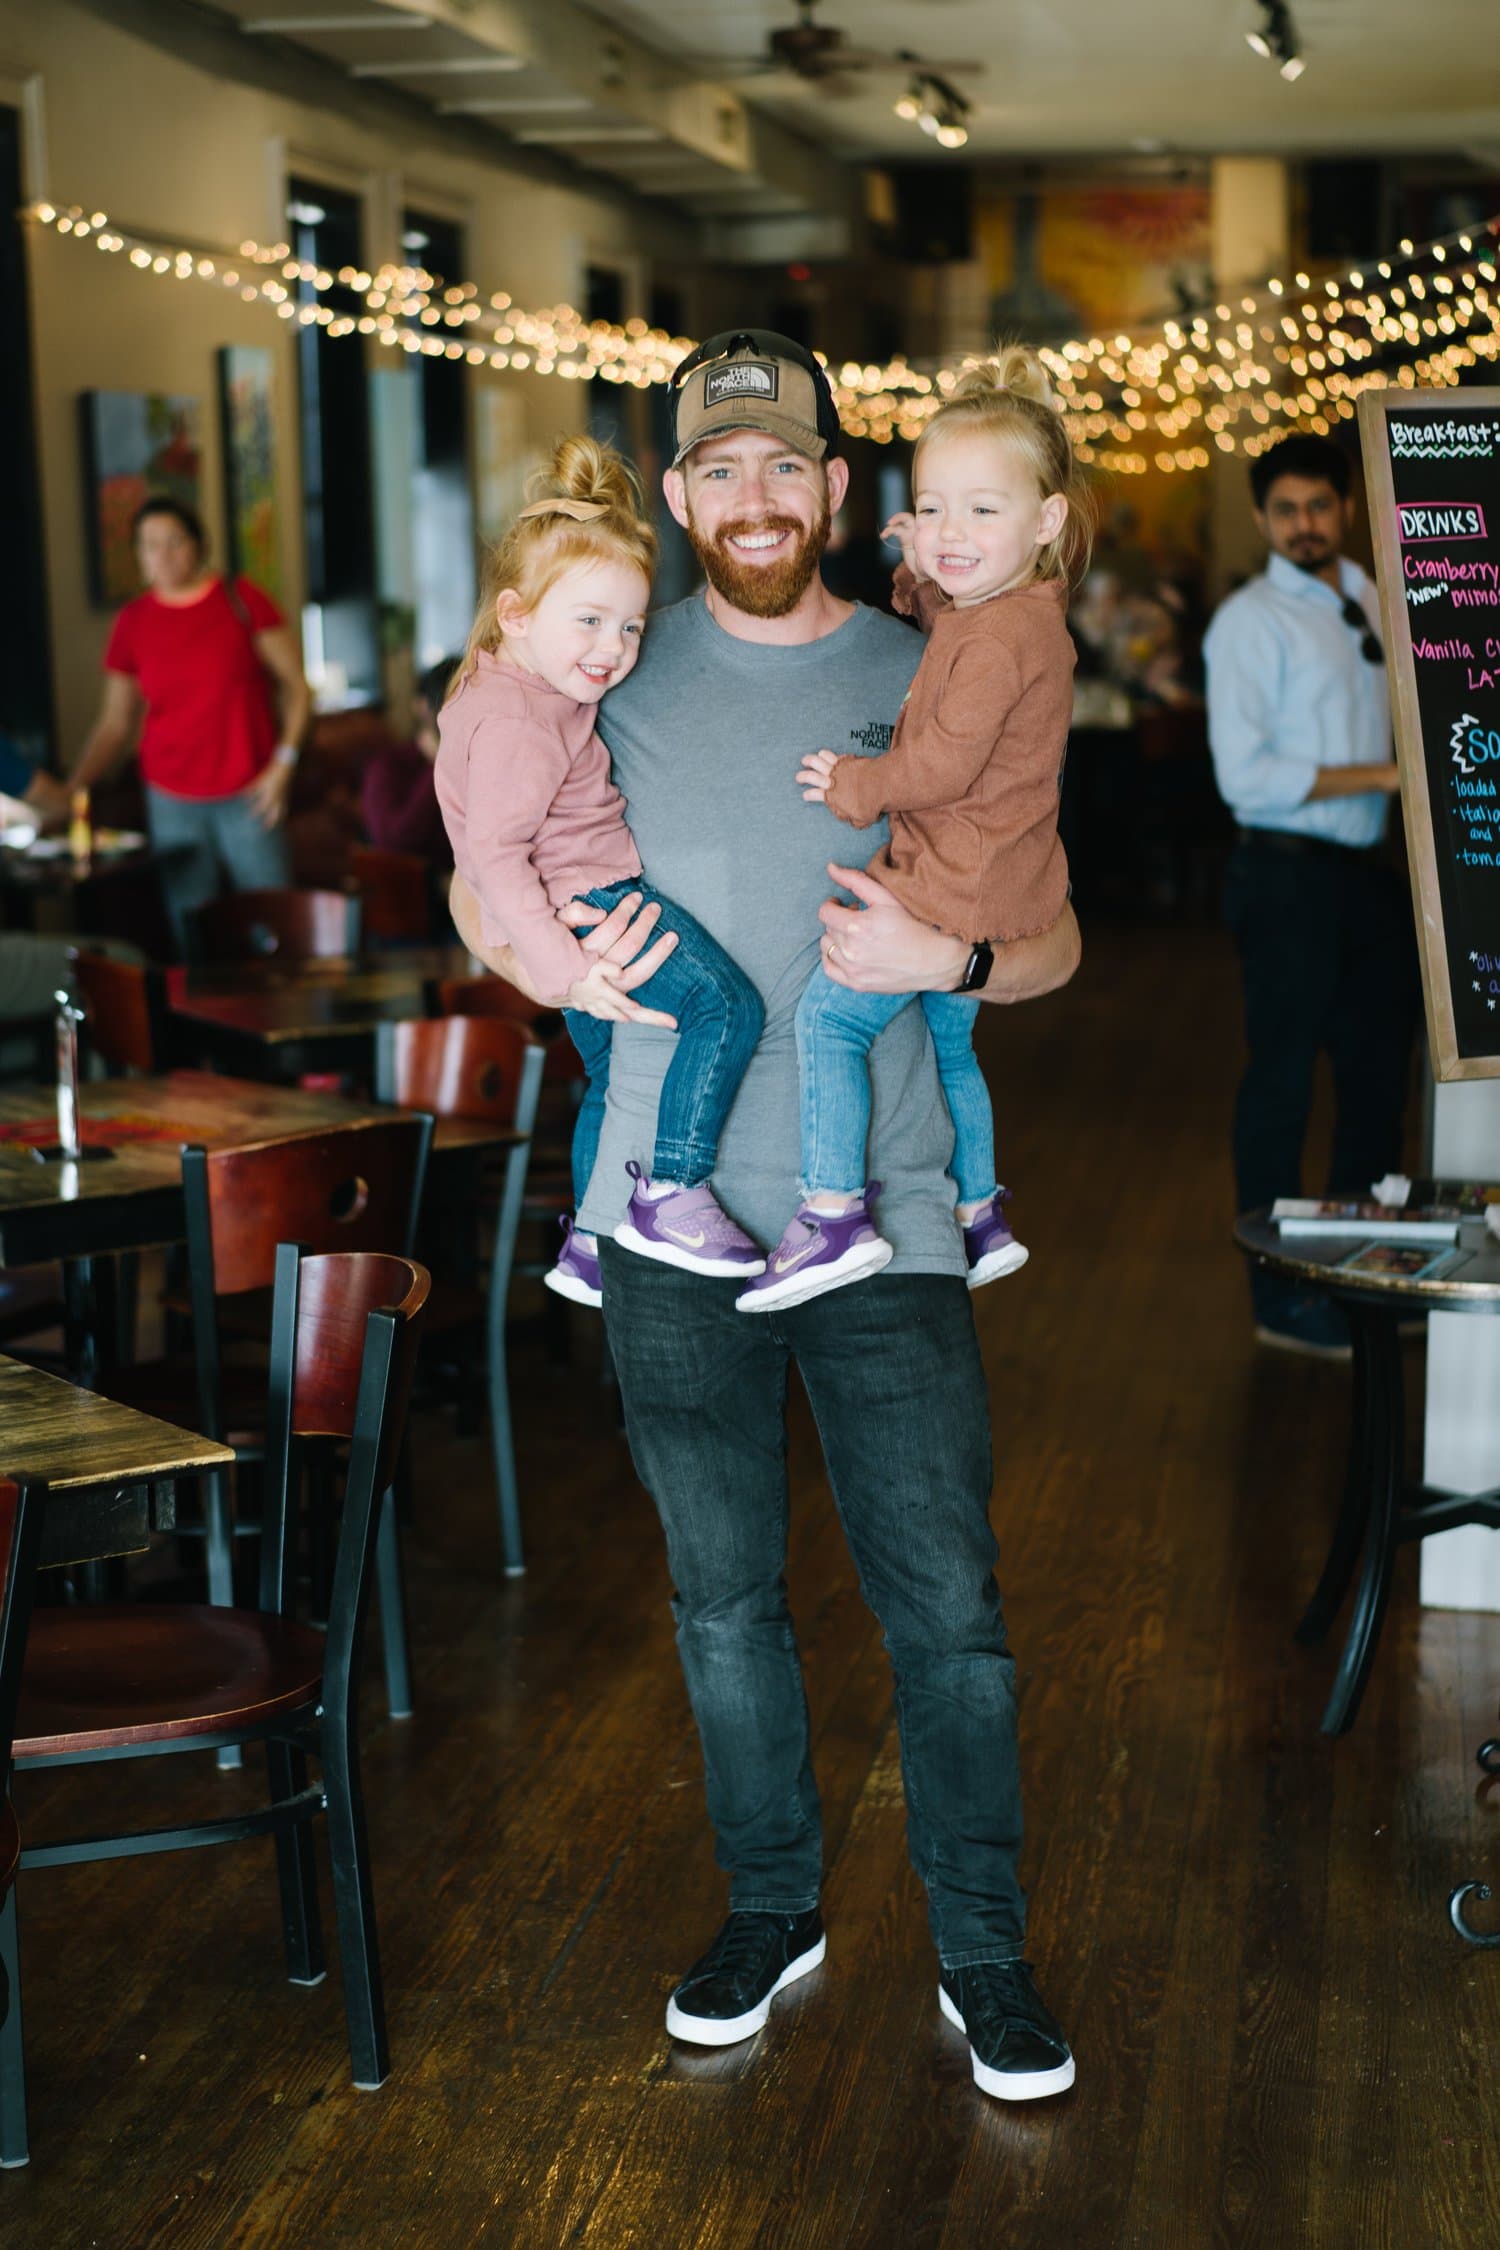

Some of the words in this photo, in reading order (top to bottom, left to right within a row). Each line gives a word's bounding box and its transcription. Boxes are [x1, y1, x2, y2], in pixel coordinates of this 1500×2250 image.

[728, 366, 750, 378] THE
[711, 374, 750, 389] NORTH
[720, 379, 750, 392] FACE
[1400, 509, 1479, 538] DRINKS
[1404, 555, 1499, 589] Cranberry
[1451, 588, 1500, 608] mimo
[1412, 637, 1475, 660] Vanilla
[868, 721, 889, 733] THE
[850, 730, 889, 741] NORTH
[861, 739, 889, 750] FACE
[1470, 825, 1493, 842] and
